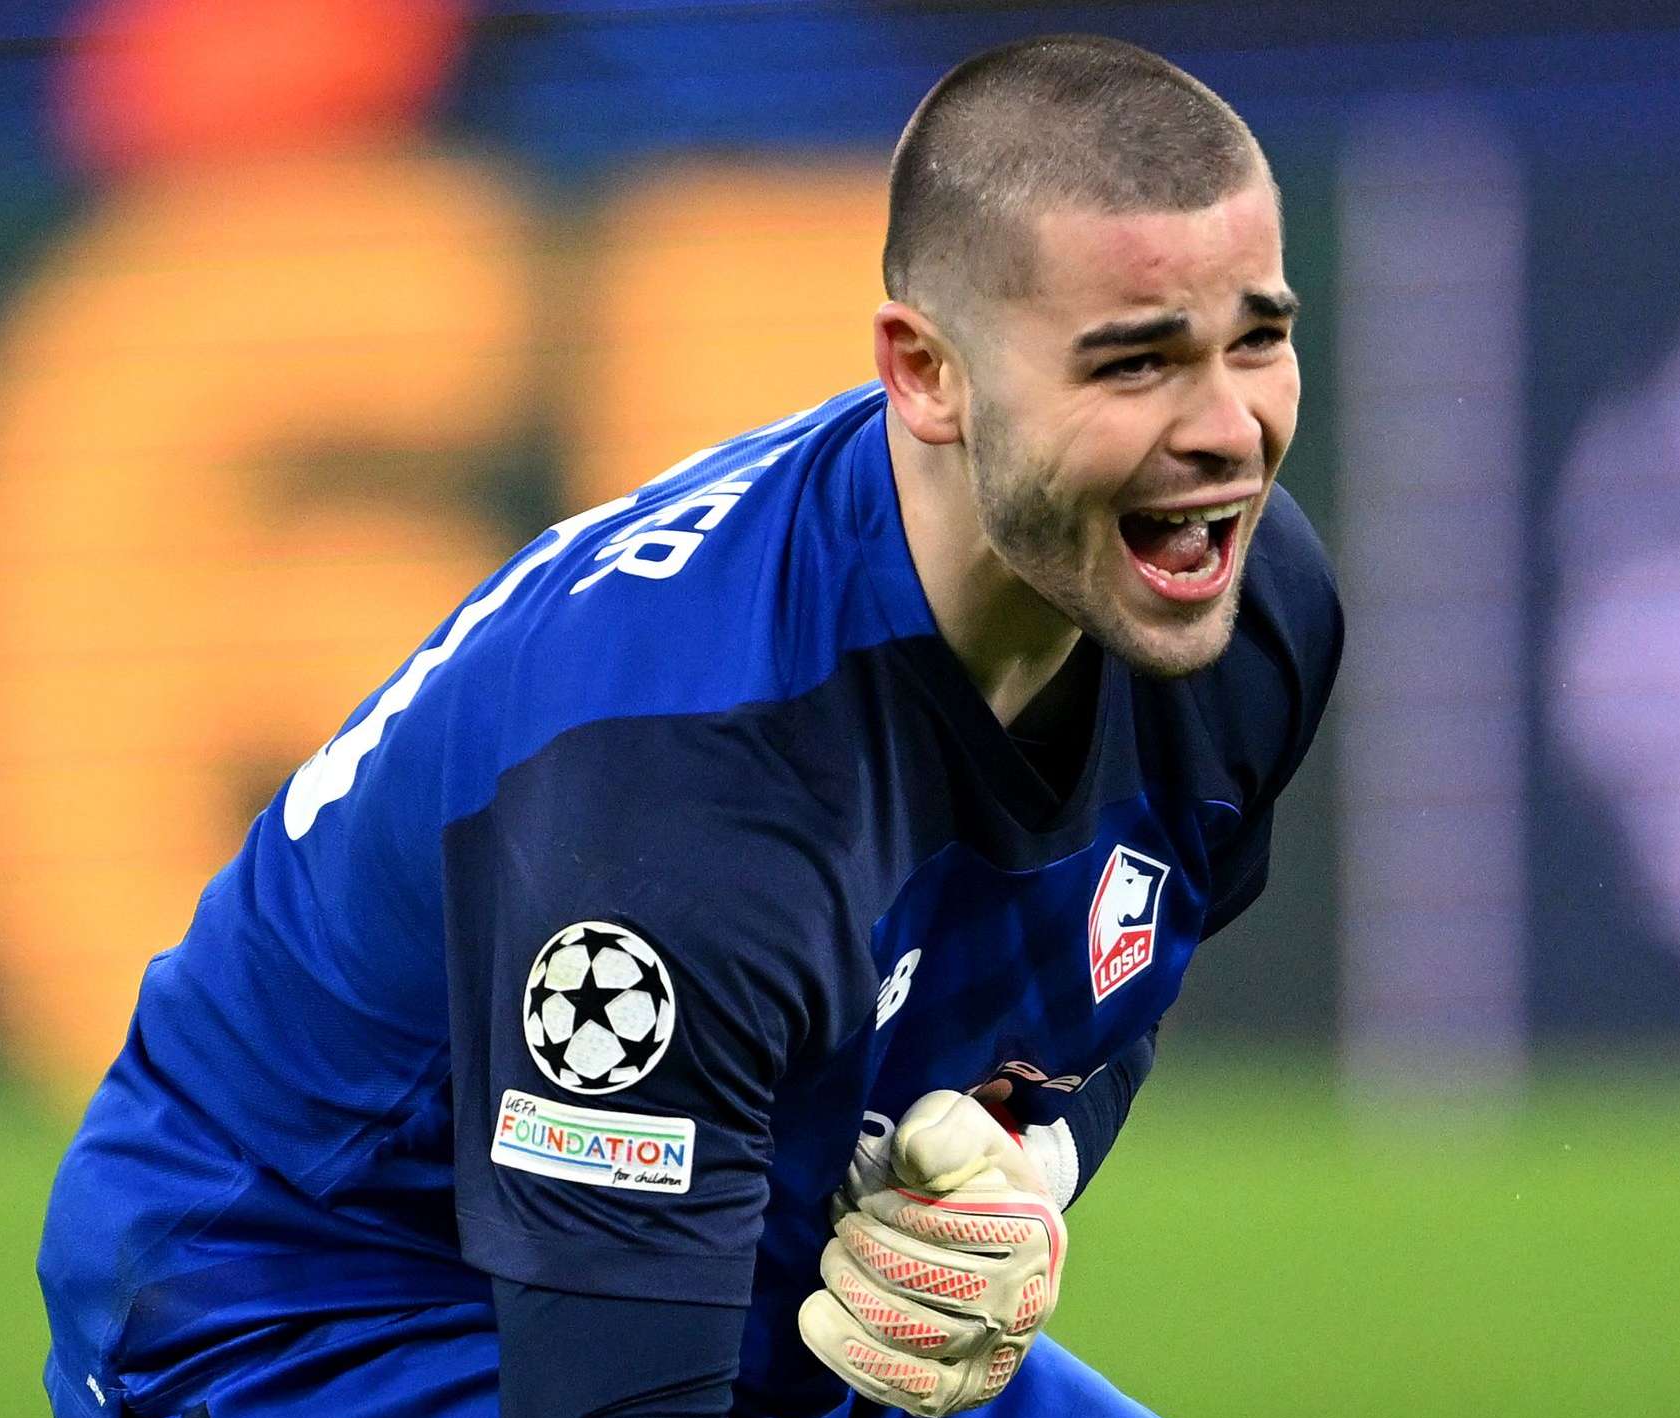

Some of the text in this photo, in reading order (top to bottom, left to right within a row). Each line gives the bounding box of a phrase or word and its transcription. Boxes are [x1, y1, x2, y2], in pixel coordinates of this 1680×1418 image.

[1099, 936, 1147, 991] LOSC
[505, 1095, 537, 1116] UEFA
[612, 1168, 682, 1187] for children
